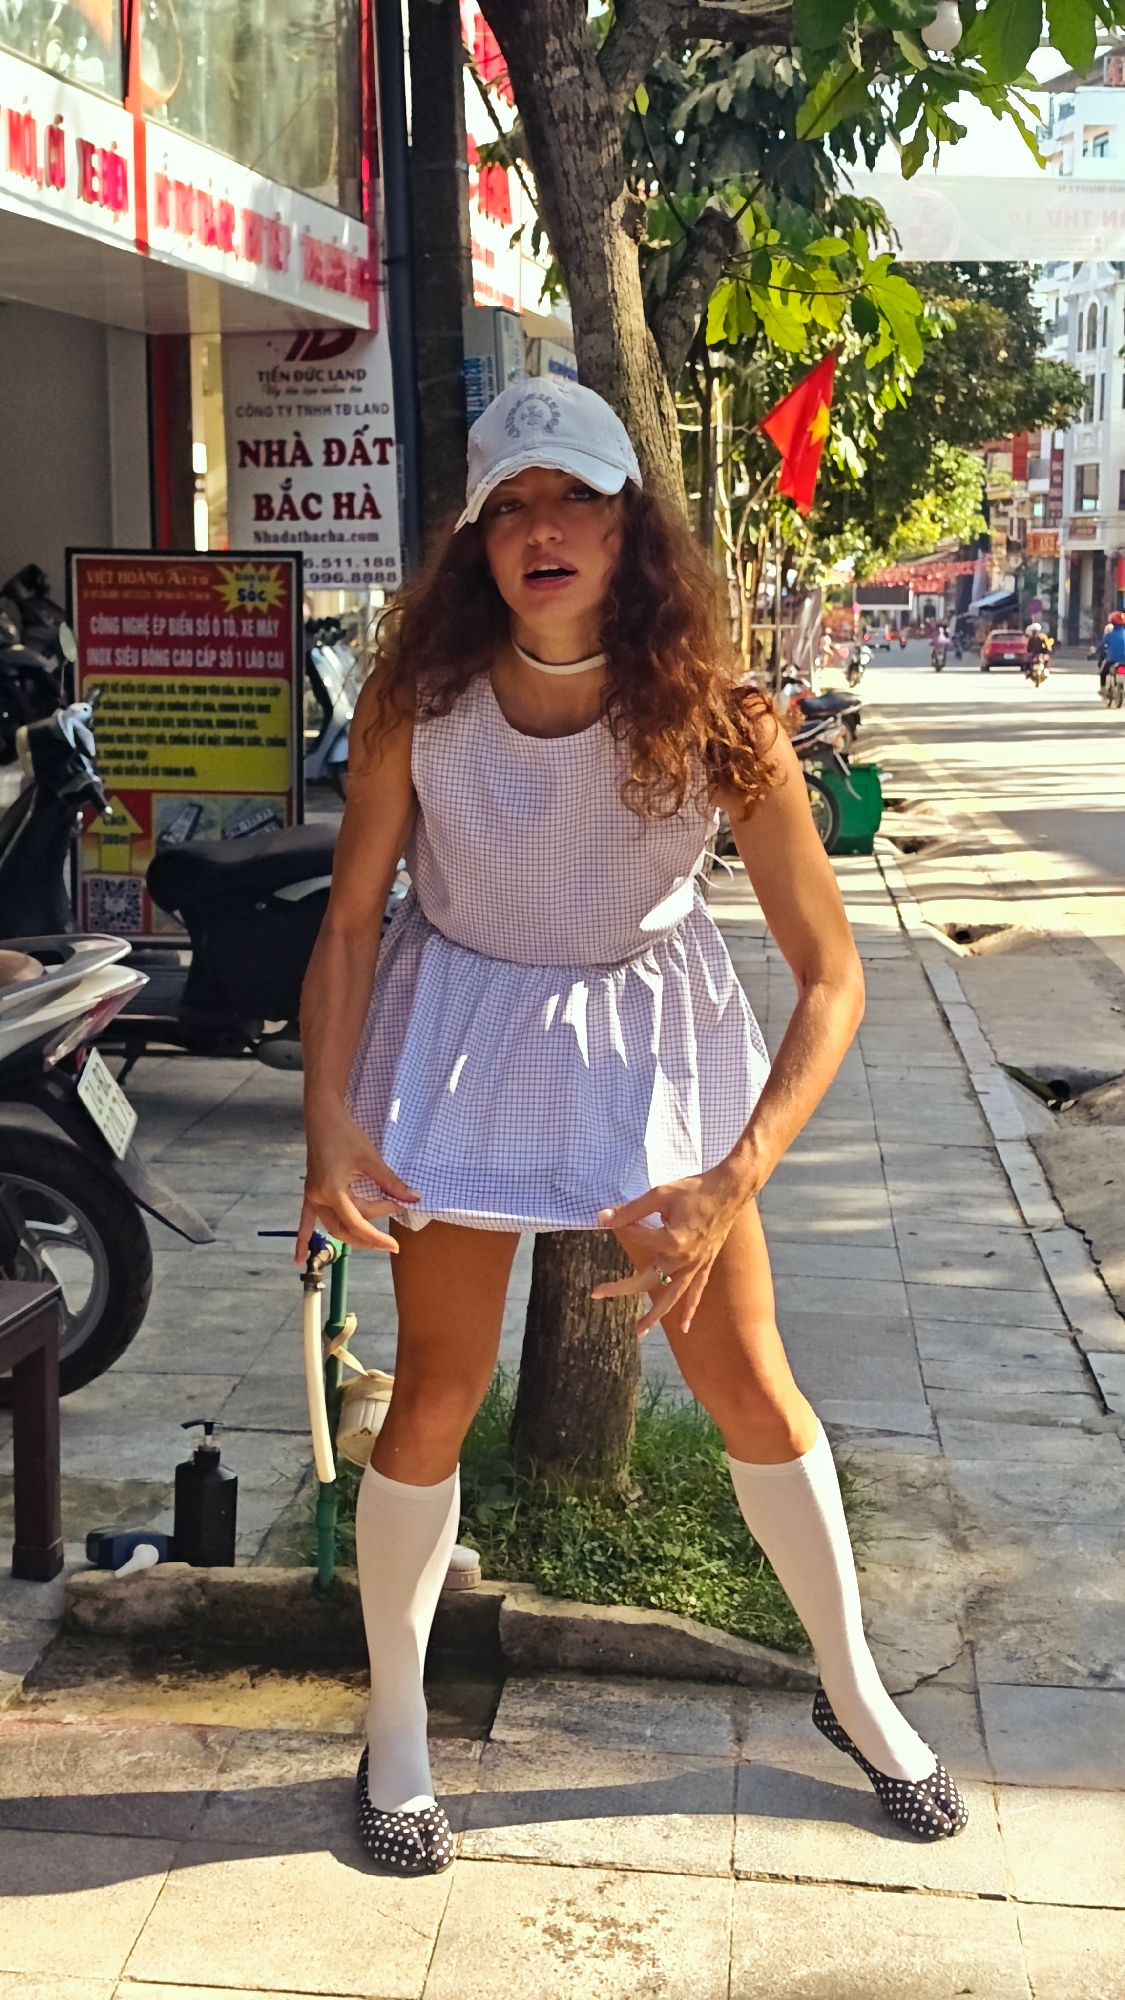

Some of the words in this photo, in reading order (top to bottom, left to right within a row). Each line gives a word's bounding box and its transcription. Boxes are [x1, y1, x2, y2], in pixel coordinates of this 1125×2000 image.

[328, 368, 367, 382] LAND
[235, 403, 273, 418] CÔNG
[277, 405, 292, 417] TY
[295, 404, 332, 417] TNHH
[354, 402, 390, 415] LAND
[237, 430, 313, 468] NHÀ
[322, 423, 394, 468] ĐẤT
[253, 477, 323, 521] BẮC
[332, 482, 382, 520] HÀ
[253, 530, 379, 544] Nhadatbacha.com
[241, 618, 254, 637] XE
[173, 648, 193, 668] CAO
[236, 651, 242, 668] 1
